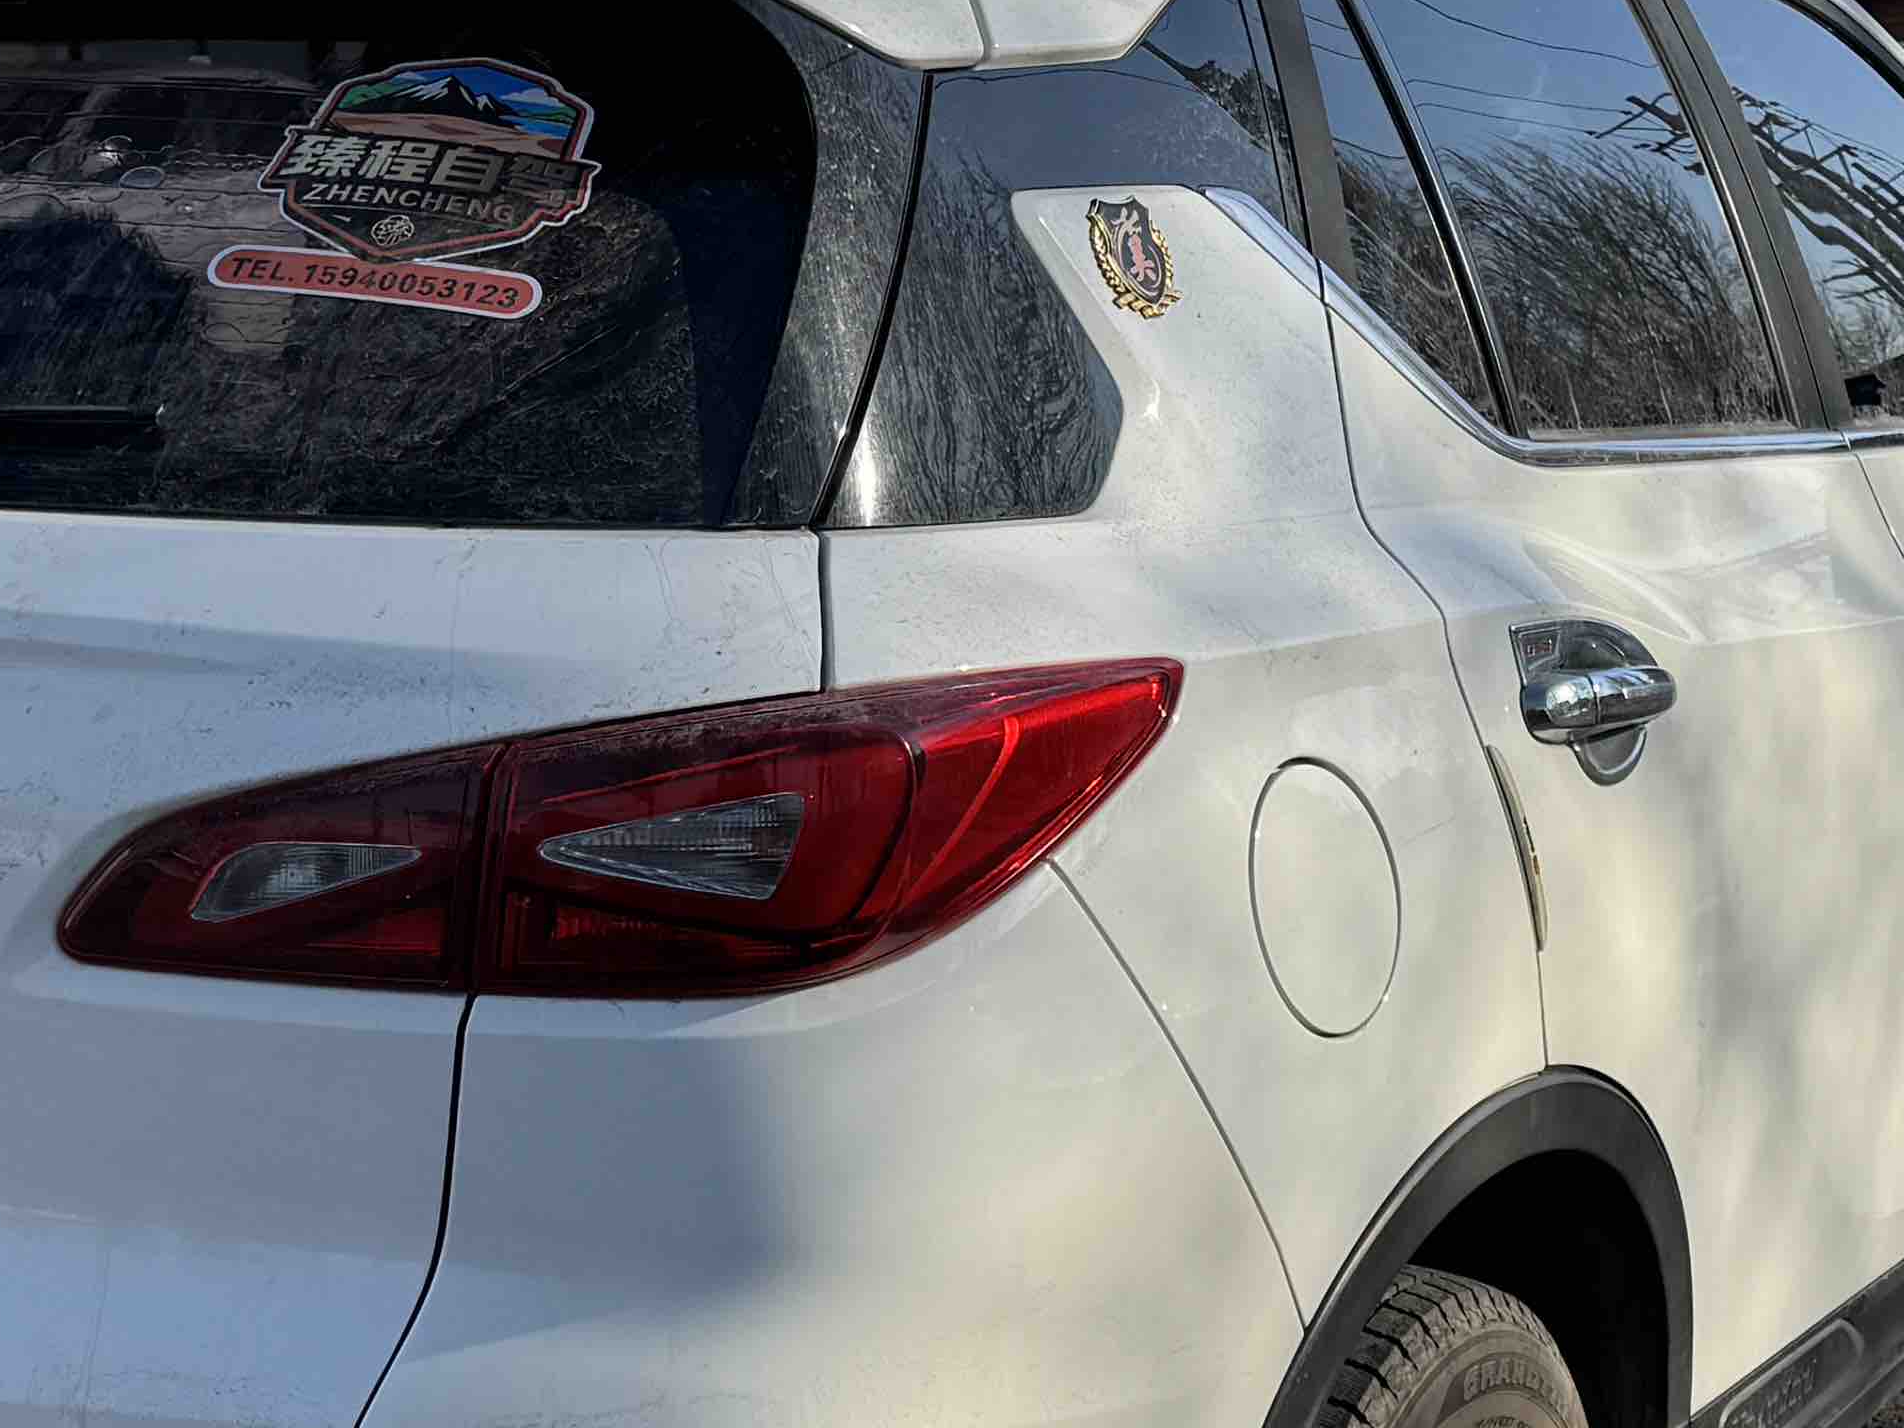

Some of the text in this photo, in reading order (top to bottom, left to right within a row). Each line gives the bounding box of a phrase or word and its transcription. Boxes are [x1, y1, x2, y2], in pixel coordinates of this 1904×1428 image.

[303, 182, 515, 224] ZHENCHENG
[232, 256, 522, 308] TEL. 15940053123
